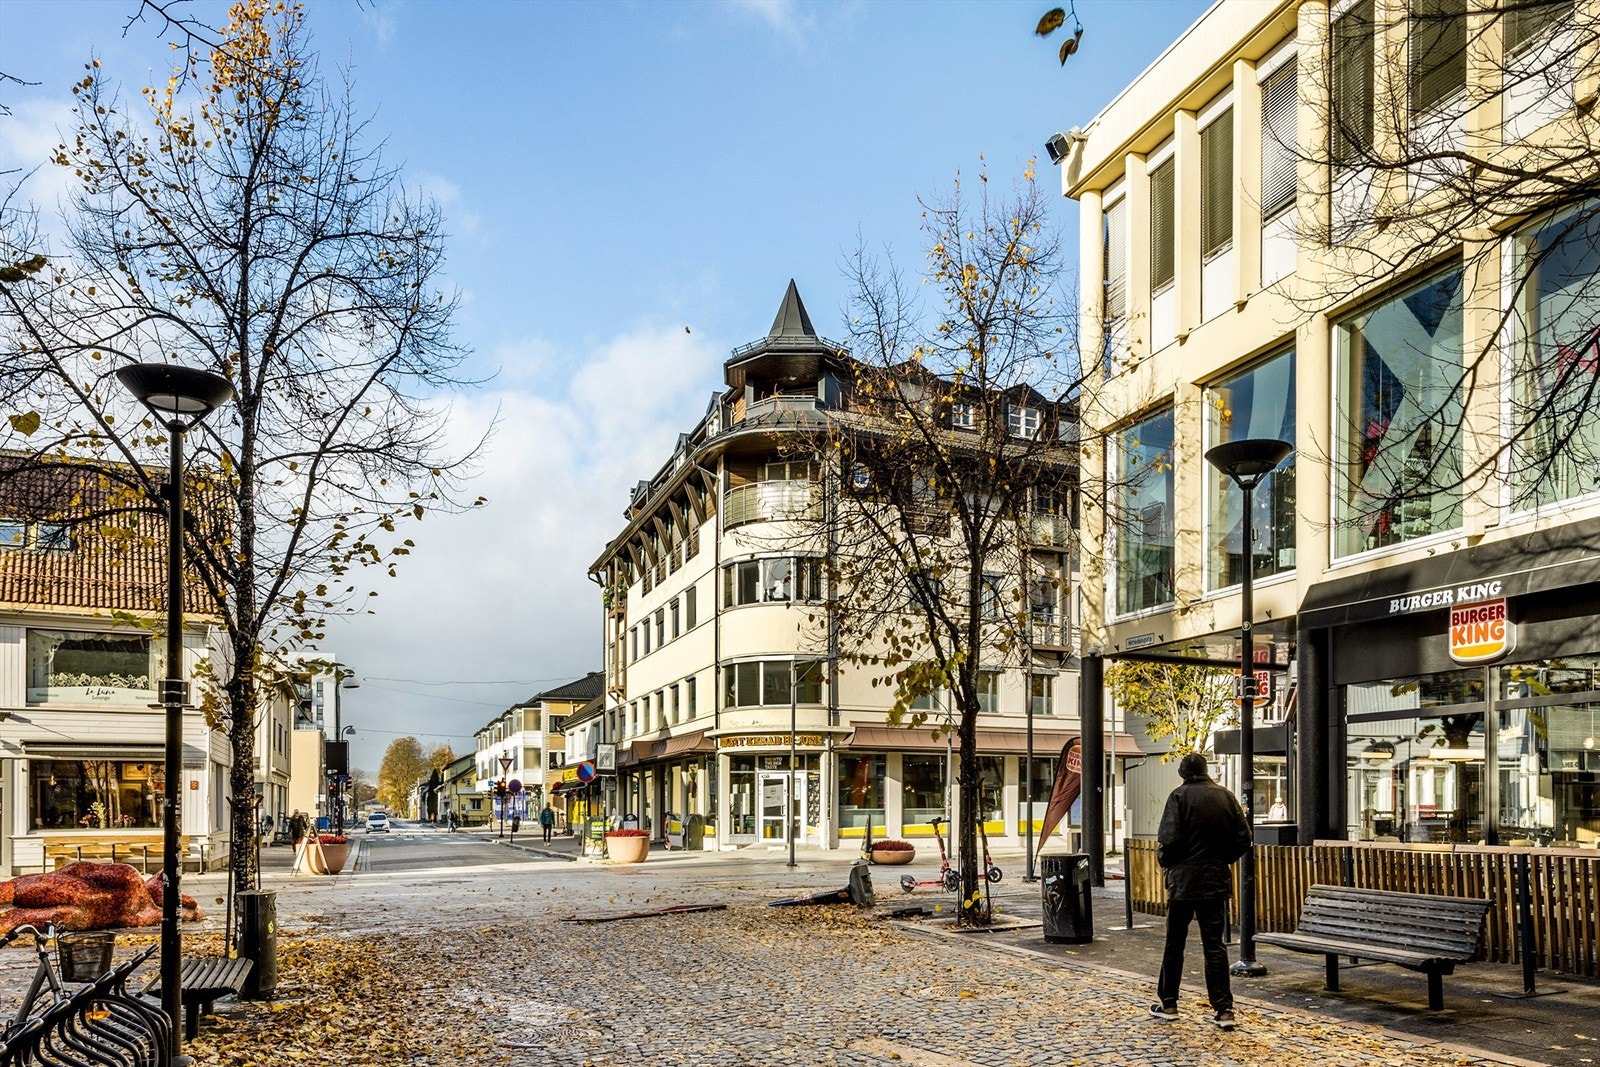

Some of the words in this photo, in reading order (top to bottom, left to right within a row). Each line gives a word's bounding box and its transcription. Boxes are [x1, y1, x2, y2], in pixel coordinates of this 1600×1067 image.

[1389, 589, 1454, 613] BURGER
[1456, 580, 1502, 601] KING
[1452, 605, 1505, 627] BURGER
[1452, 620, 1505, 646] KING
[746, 735, 782, 746] KEBAB
[1067, 757, 1082, 767] KIN
